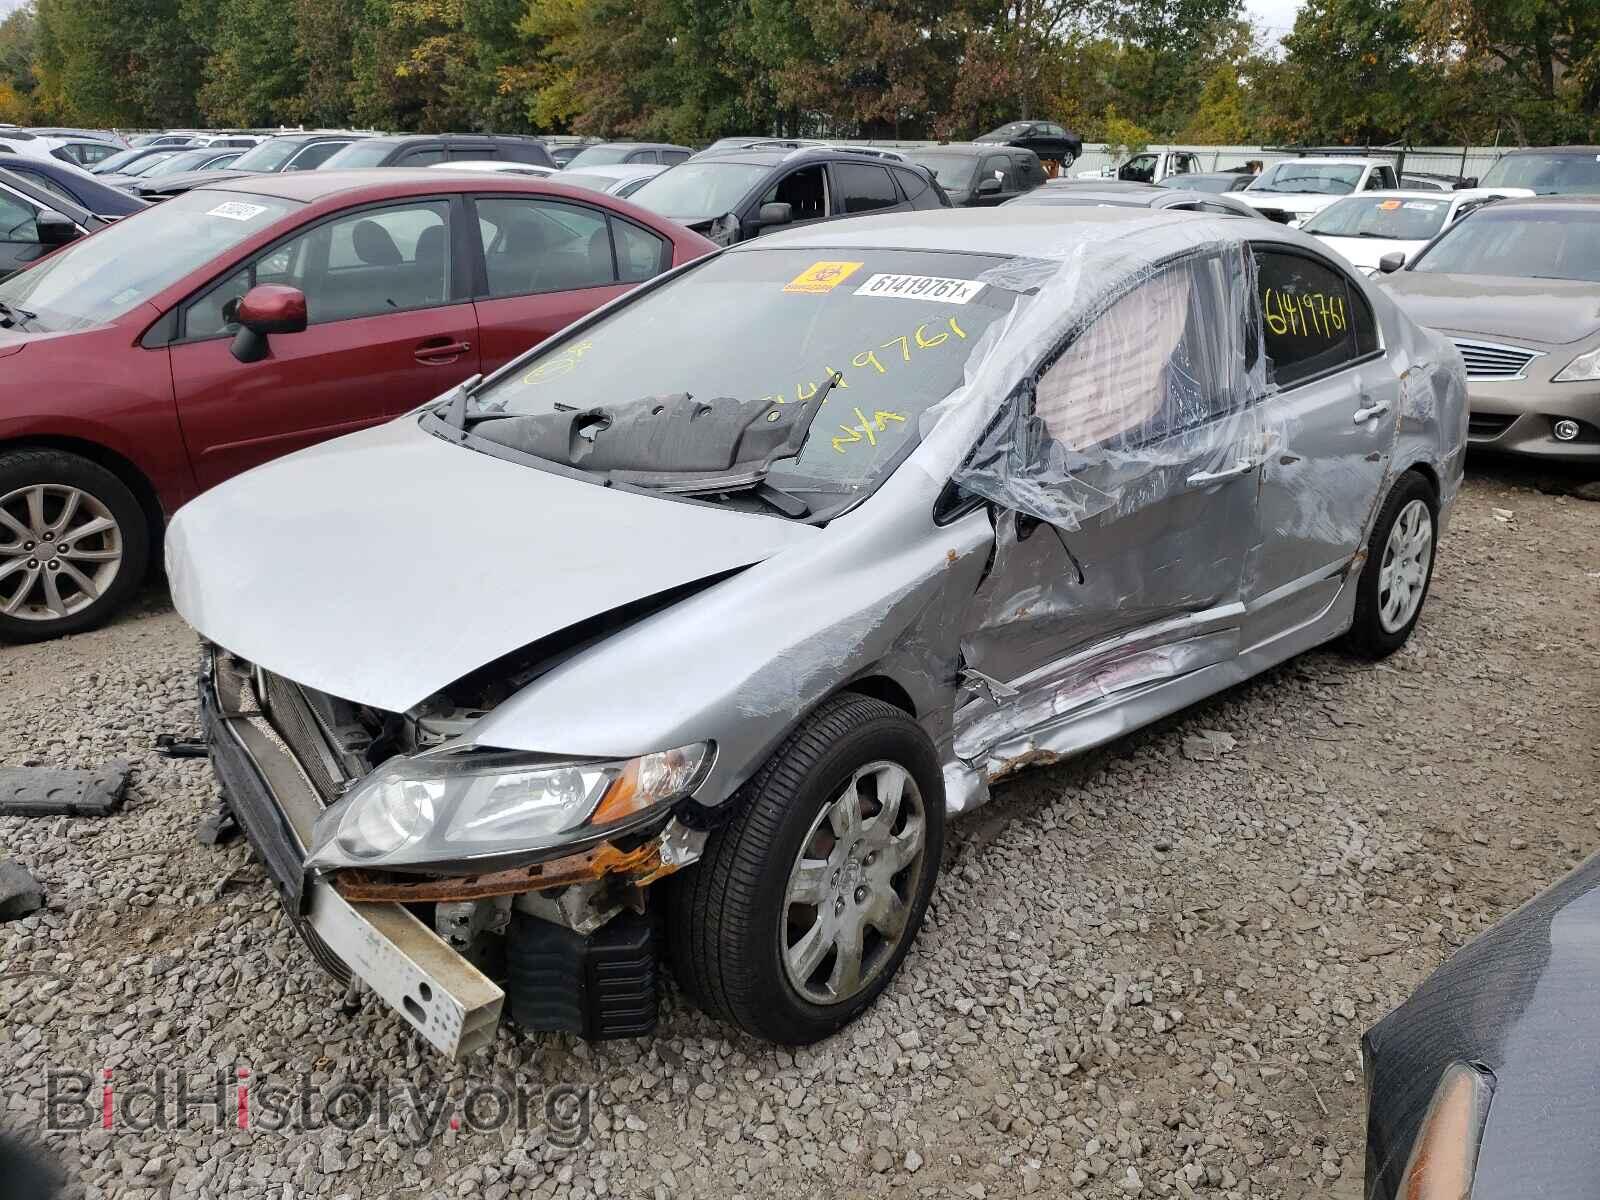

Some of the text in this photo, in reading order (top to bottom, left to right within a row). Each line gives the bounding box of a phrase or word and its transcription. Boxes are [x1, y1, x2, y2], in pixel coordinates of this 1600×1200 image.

[1264, 287, 1347, 339] 61419761
[761, 316, 966, 404] 419761
[832, 407, 906, 453] N/A
